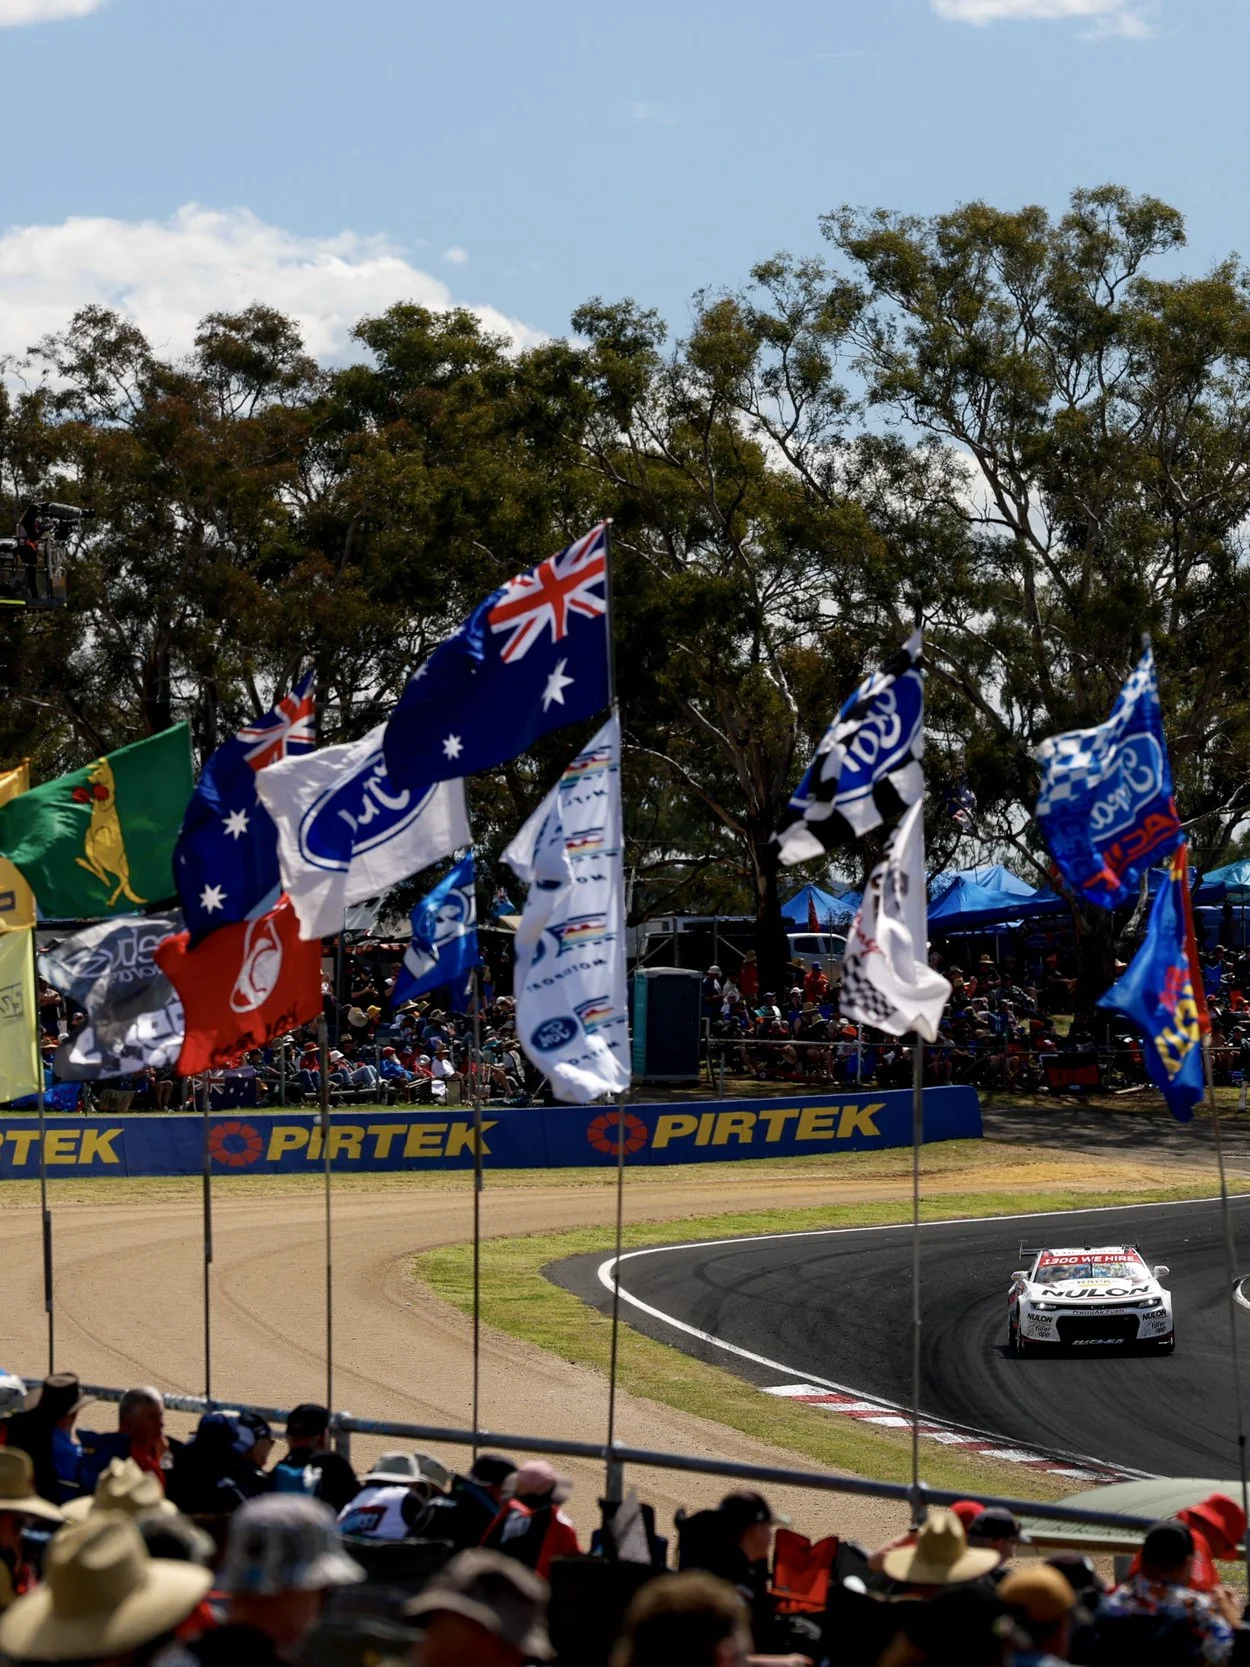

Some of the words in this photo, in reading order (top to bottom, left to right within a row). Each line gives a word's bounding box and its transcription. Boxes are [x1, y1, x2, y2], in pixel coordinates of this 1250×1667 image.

[651, 1103, 885, 1148] PIRTEK
[0, 1128, 124, 1165] TEK
[266, 1121, 498, 1161] PIRTEK
[1042, 1257, 1078, 1266] 1300
[1081, 1255, 1102, 1264] WE
[1104, 1253, 1136, 1263] HIRE
[1042, 1285, 1149, 1298] NULON
[1027, 1313, 1053, 1324] NULON
[1142, 1309, 1167, 1321] NULON
